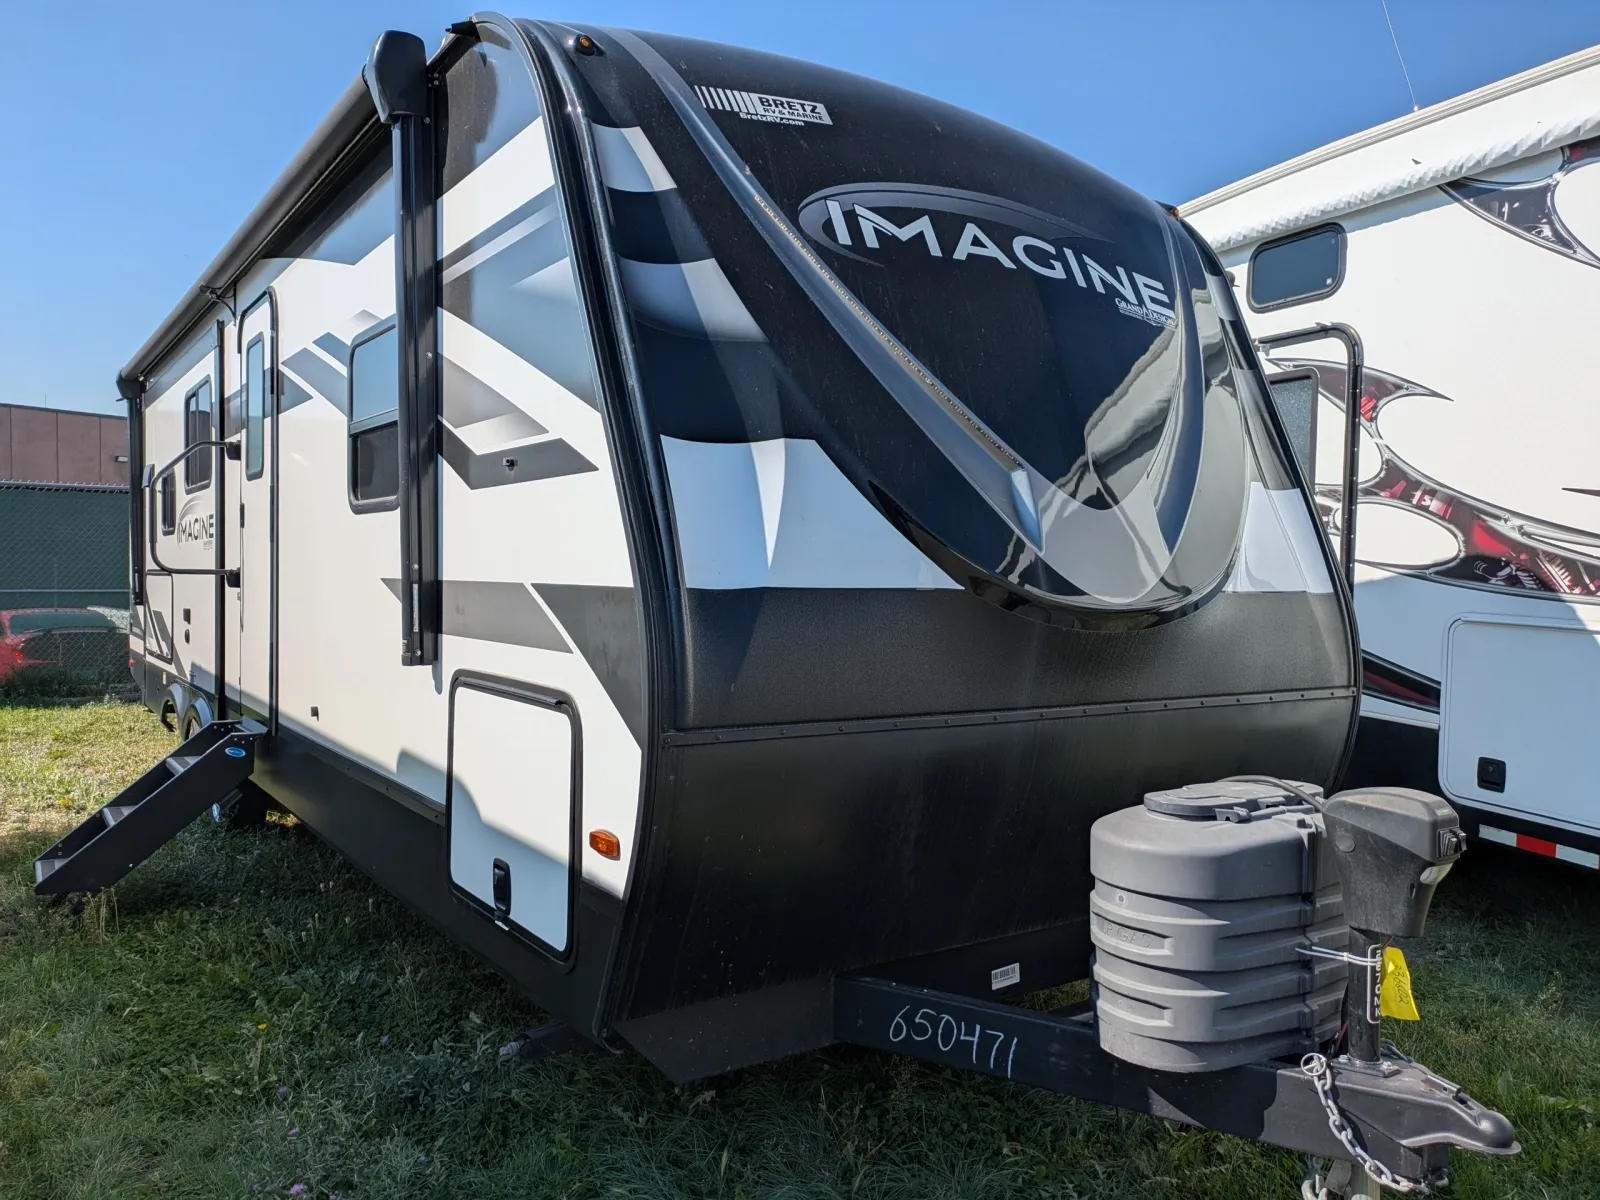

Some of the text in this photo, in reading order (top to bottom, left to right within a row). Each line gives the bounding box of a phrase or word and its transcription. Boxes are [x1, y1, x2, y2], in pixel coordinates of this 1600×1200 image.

[758, 96, 821, 115] BRETZ
[788, 110, 825, 122] MARINE
[740, 112, 805, 126] BretzRV.com
[825, 200, 1176, 319] IMAGINE
[177, 513, 214, 543] IMAGINE
[889, 1005, 1018, 1079] 650471
